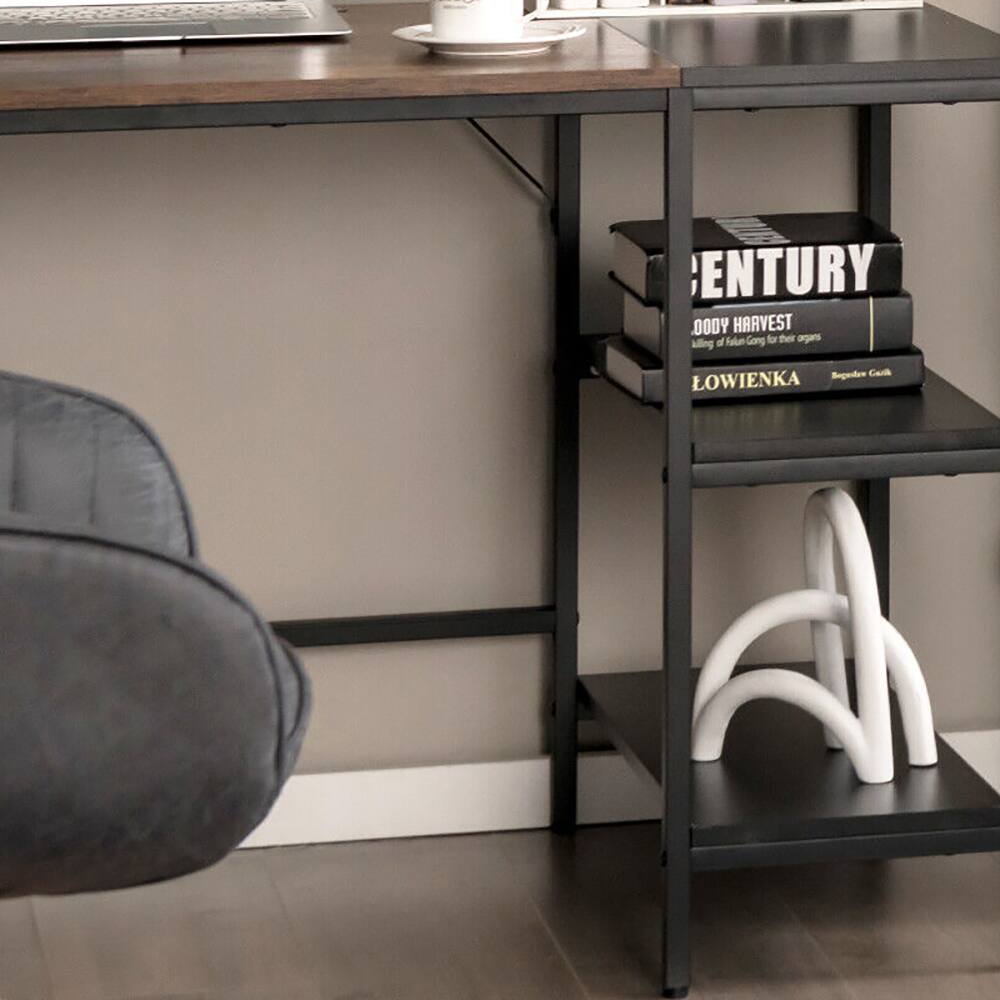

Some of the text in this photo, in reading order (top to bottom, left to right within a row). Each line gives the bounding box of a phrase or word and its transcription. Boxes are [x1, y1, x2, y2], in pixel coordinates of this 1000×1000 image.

[691, 313, 793, 336] OODY HARVEST
[766, 334, 778, 344] for
[779, 333, 796, 343] their
